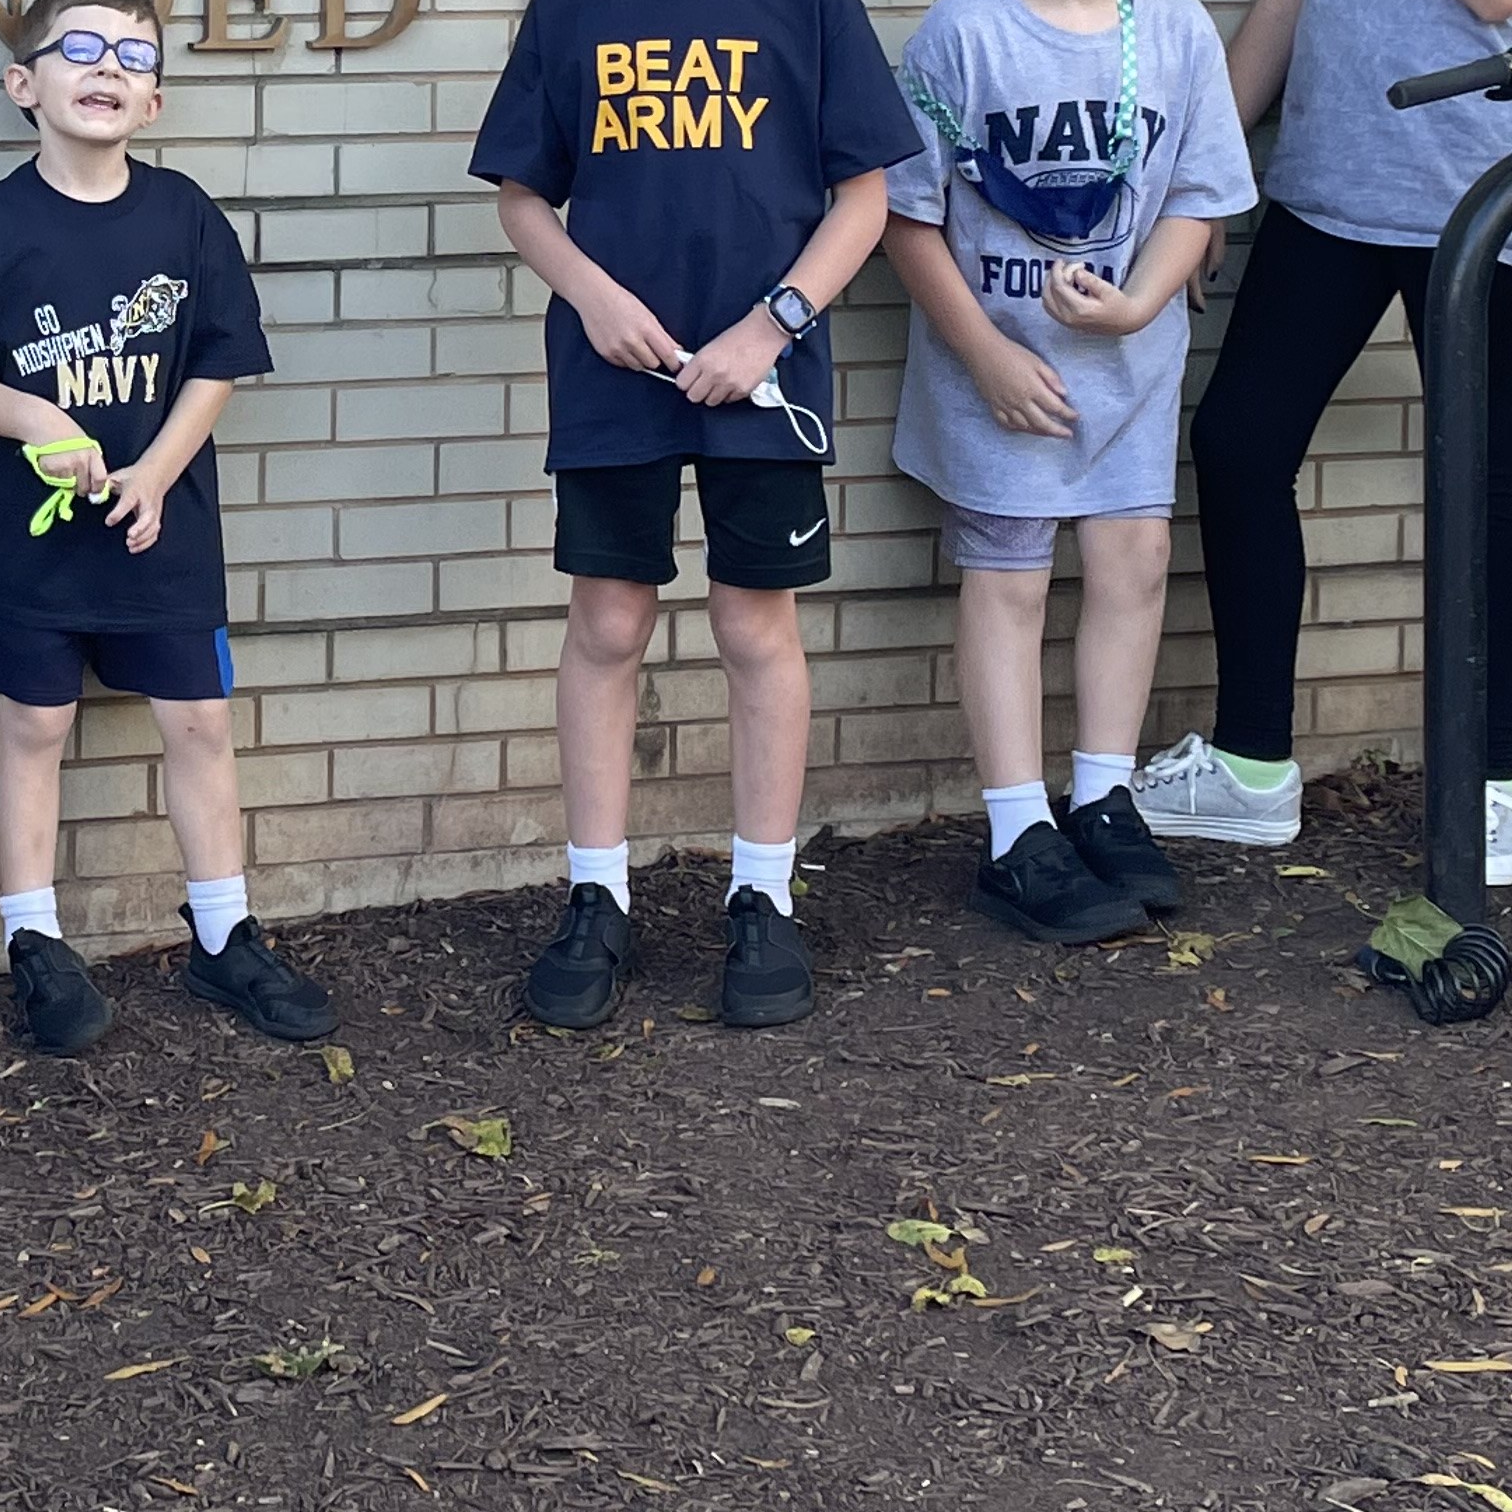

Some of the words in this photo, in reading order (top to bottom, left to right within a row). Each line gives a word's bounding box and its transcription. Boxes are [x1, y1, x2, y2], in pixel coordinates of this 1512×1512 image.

[596, 38, 759, 97] BEAT
[591, 94, 770, 154] ARMY
[33, 303, 62, 336] GO
[11, 322, 107, 378] MIDSHIPMEN
[56, 352, 160, 410] NAVY
